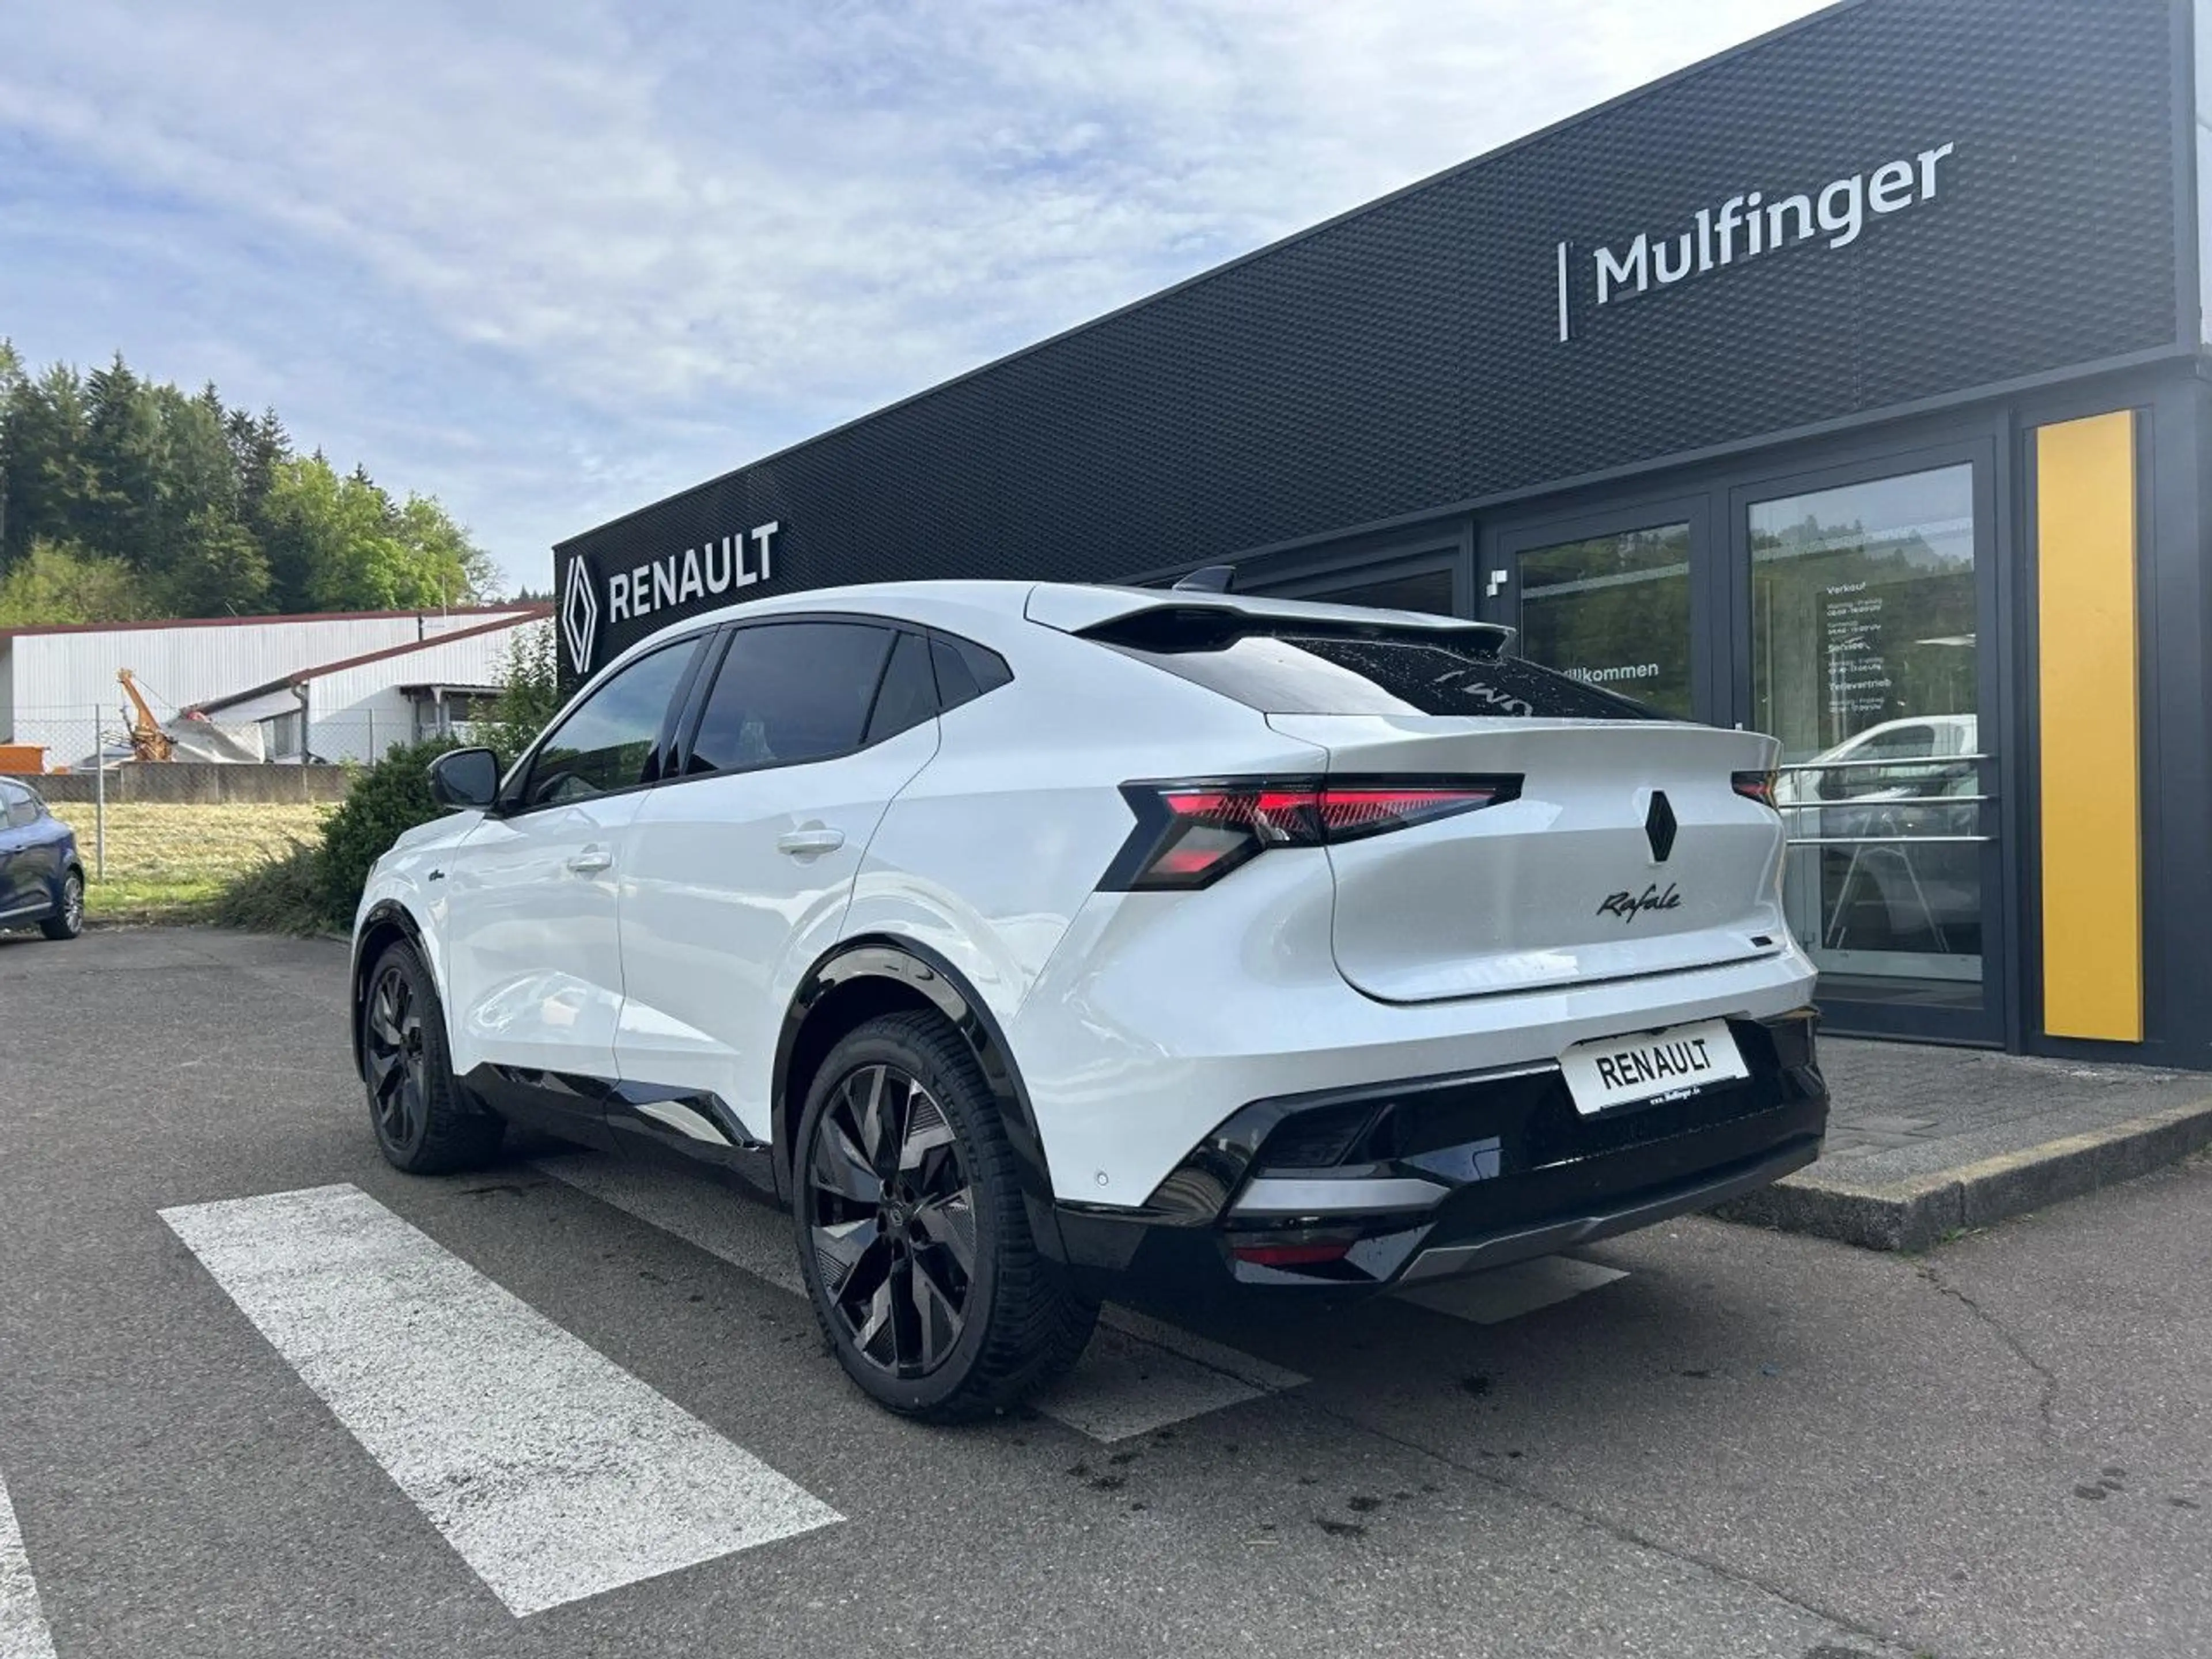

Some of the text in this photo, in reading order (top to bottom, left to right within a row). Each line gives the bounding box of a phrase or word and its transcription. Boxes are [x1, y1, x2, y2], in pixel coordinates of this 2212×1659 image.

[1593, 141, 1953, 305] Mulfinger
[609, 521, 778, 624] RENAULT
[1826, 581, 1866, 594] Verkauf
[1565, 663, 1658, 684] illkommen
[1596, 882, 1681, 924] Rafale
[1596, 1039, 1711, 1090] RENAULT
